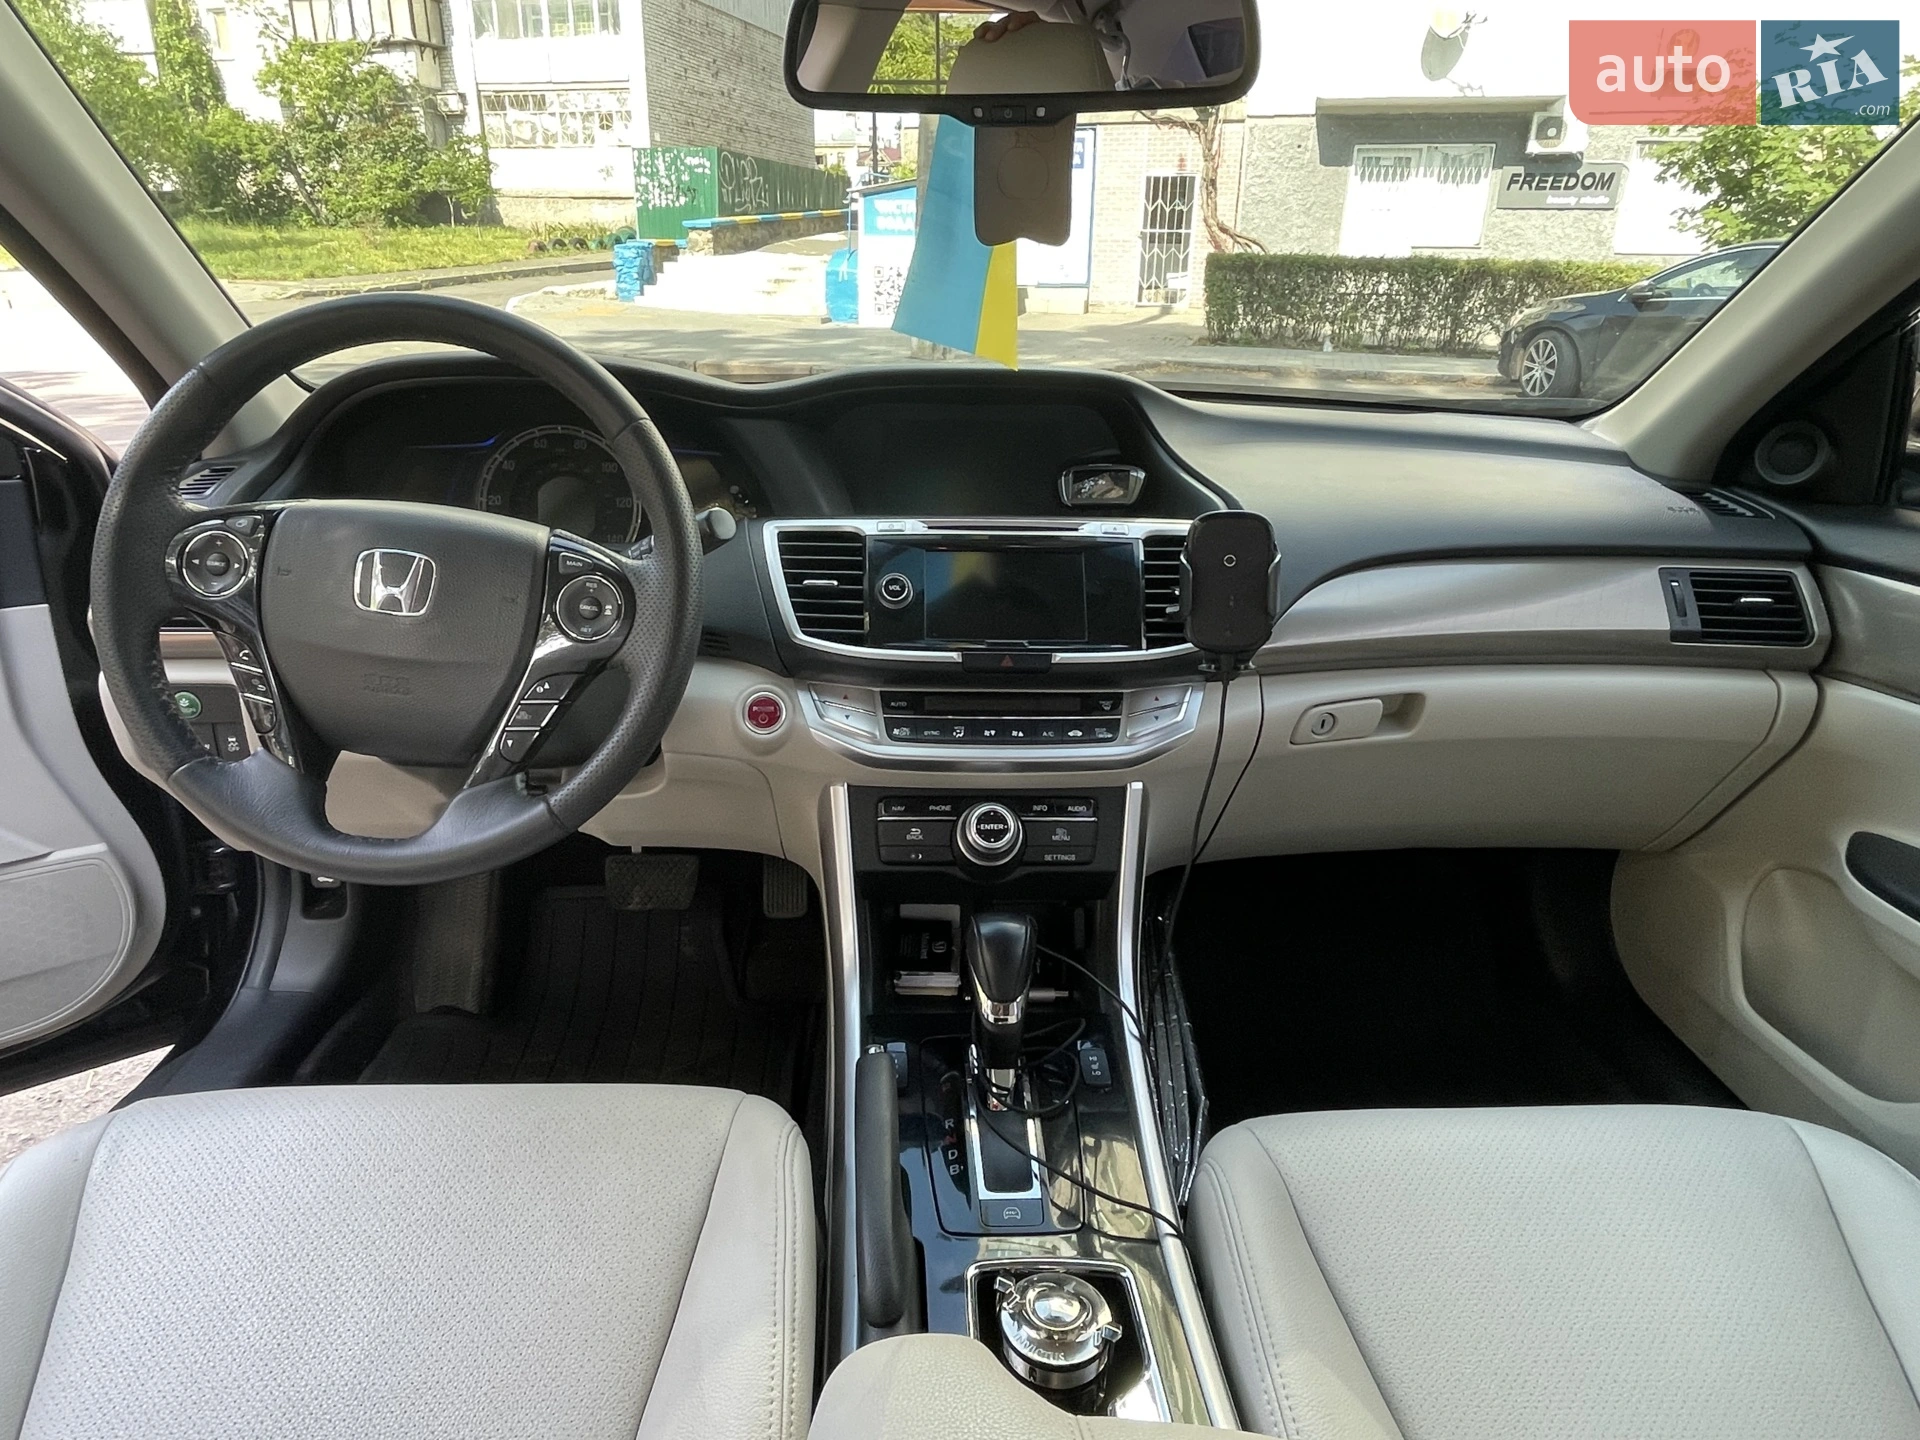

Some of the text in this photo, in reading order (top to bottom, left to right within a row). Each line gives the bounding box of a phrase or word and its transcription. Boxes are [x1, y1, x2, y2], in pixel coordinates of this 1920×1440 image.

[1506, 172, 1616, 191] FREEDOM
[533, 439, 548, 449] 60
[573, 439, 588, 450] 80
[502, 460, 515, 471] 40
[601, 461, 618, 473] 100
[488, 495, 502, 505] 20
[616, 498, 633, 508] 120
[945, 1119, 955, 1129] R
[948, 1149, 958, 1160] D
[949, 1164, 960, 1176] B
[1013, 1332, 1066, 1361] INVICTUS
